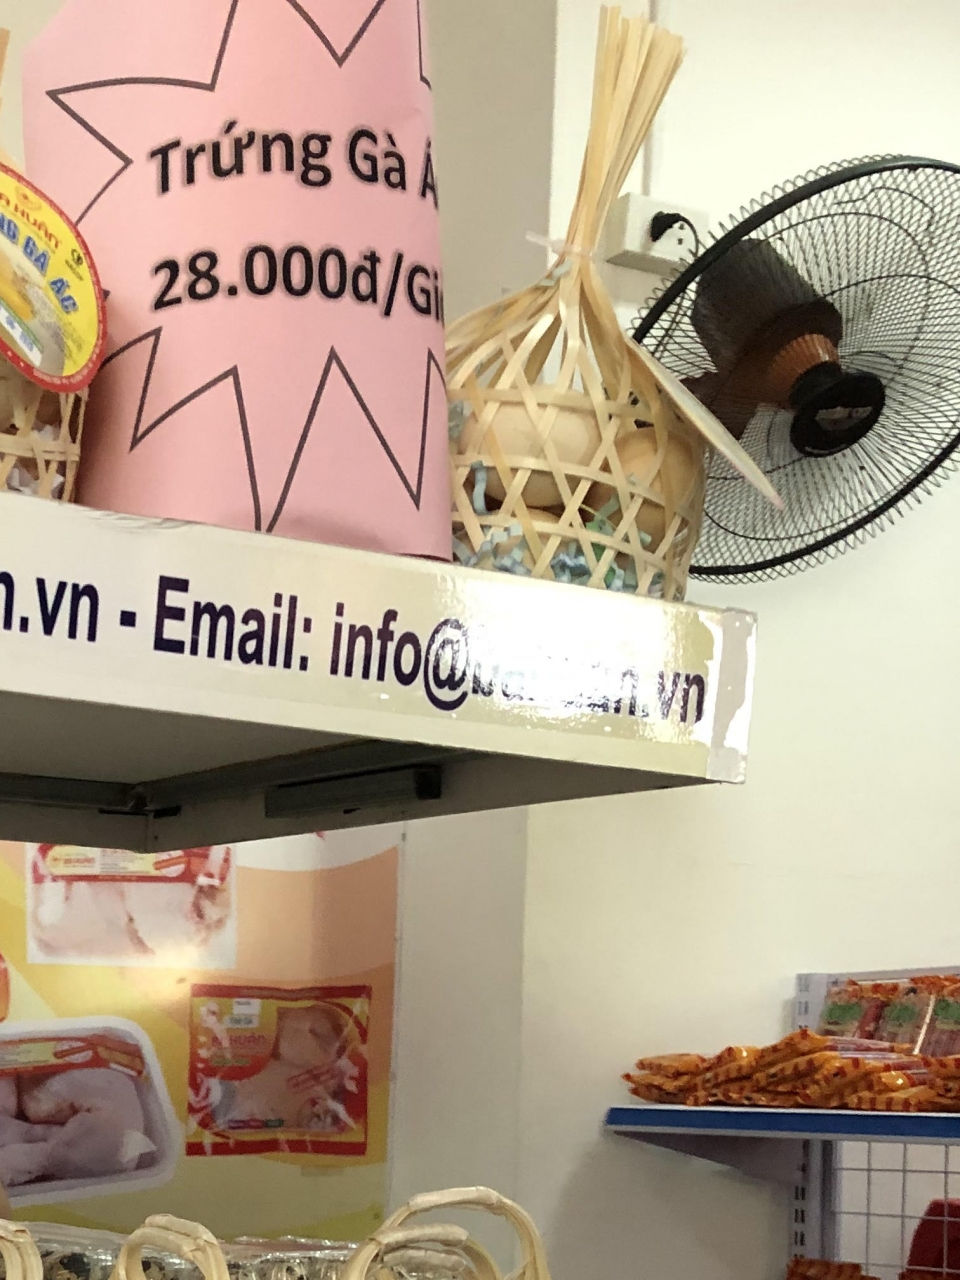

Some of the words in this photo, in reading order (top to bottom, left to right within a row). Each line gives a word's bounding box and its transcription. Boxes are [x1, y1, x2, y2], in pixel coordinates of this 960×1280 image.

[150, 120, 332, 194] Trứng
[348, 128, 406, 191] Gà
[152, 245, 445, 326] 28.000đ/Gi
[154, 575, 312, 671] Email:
